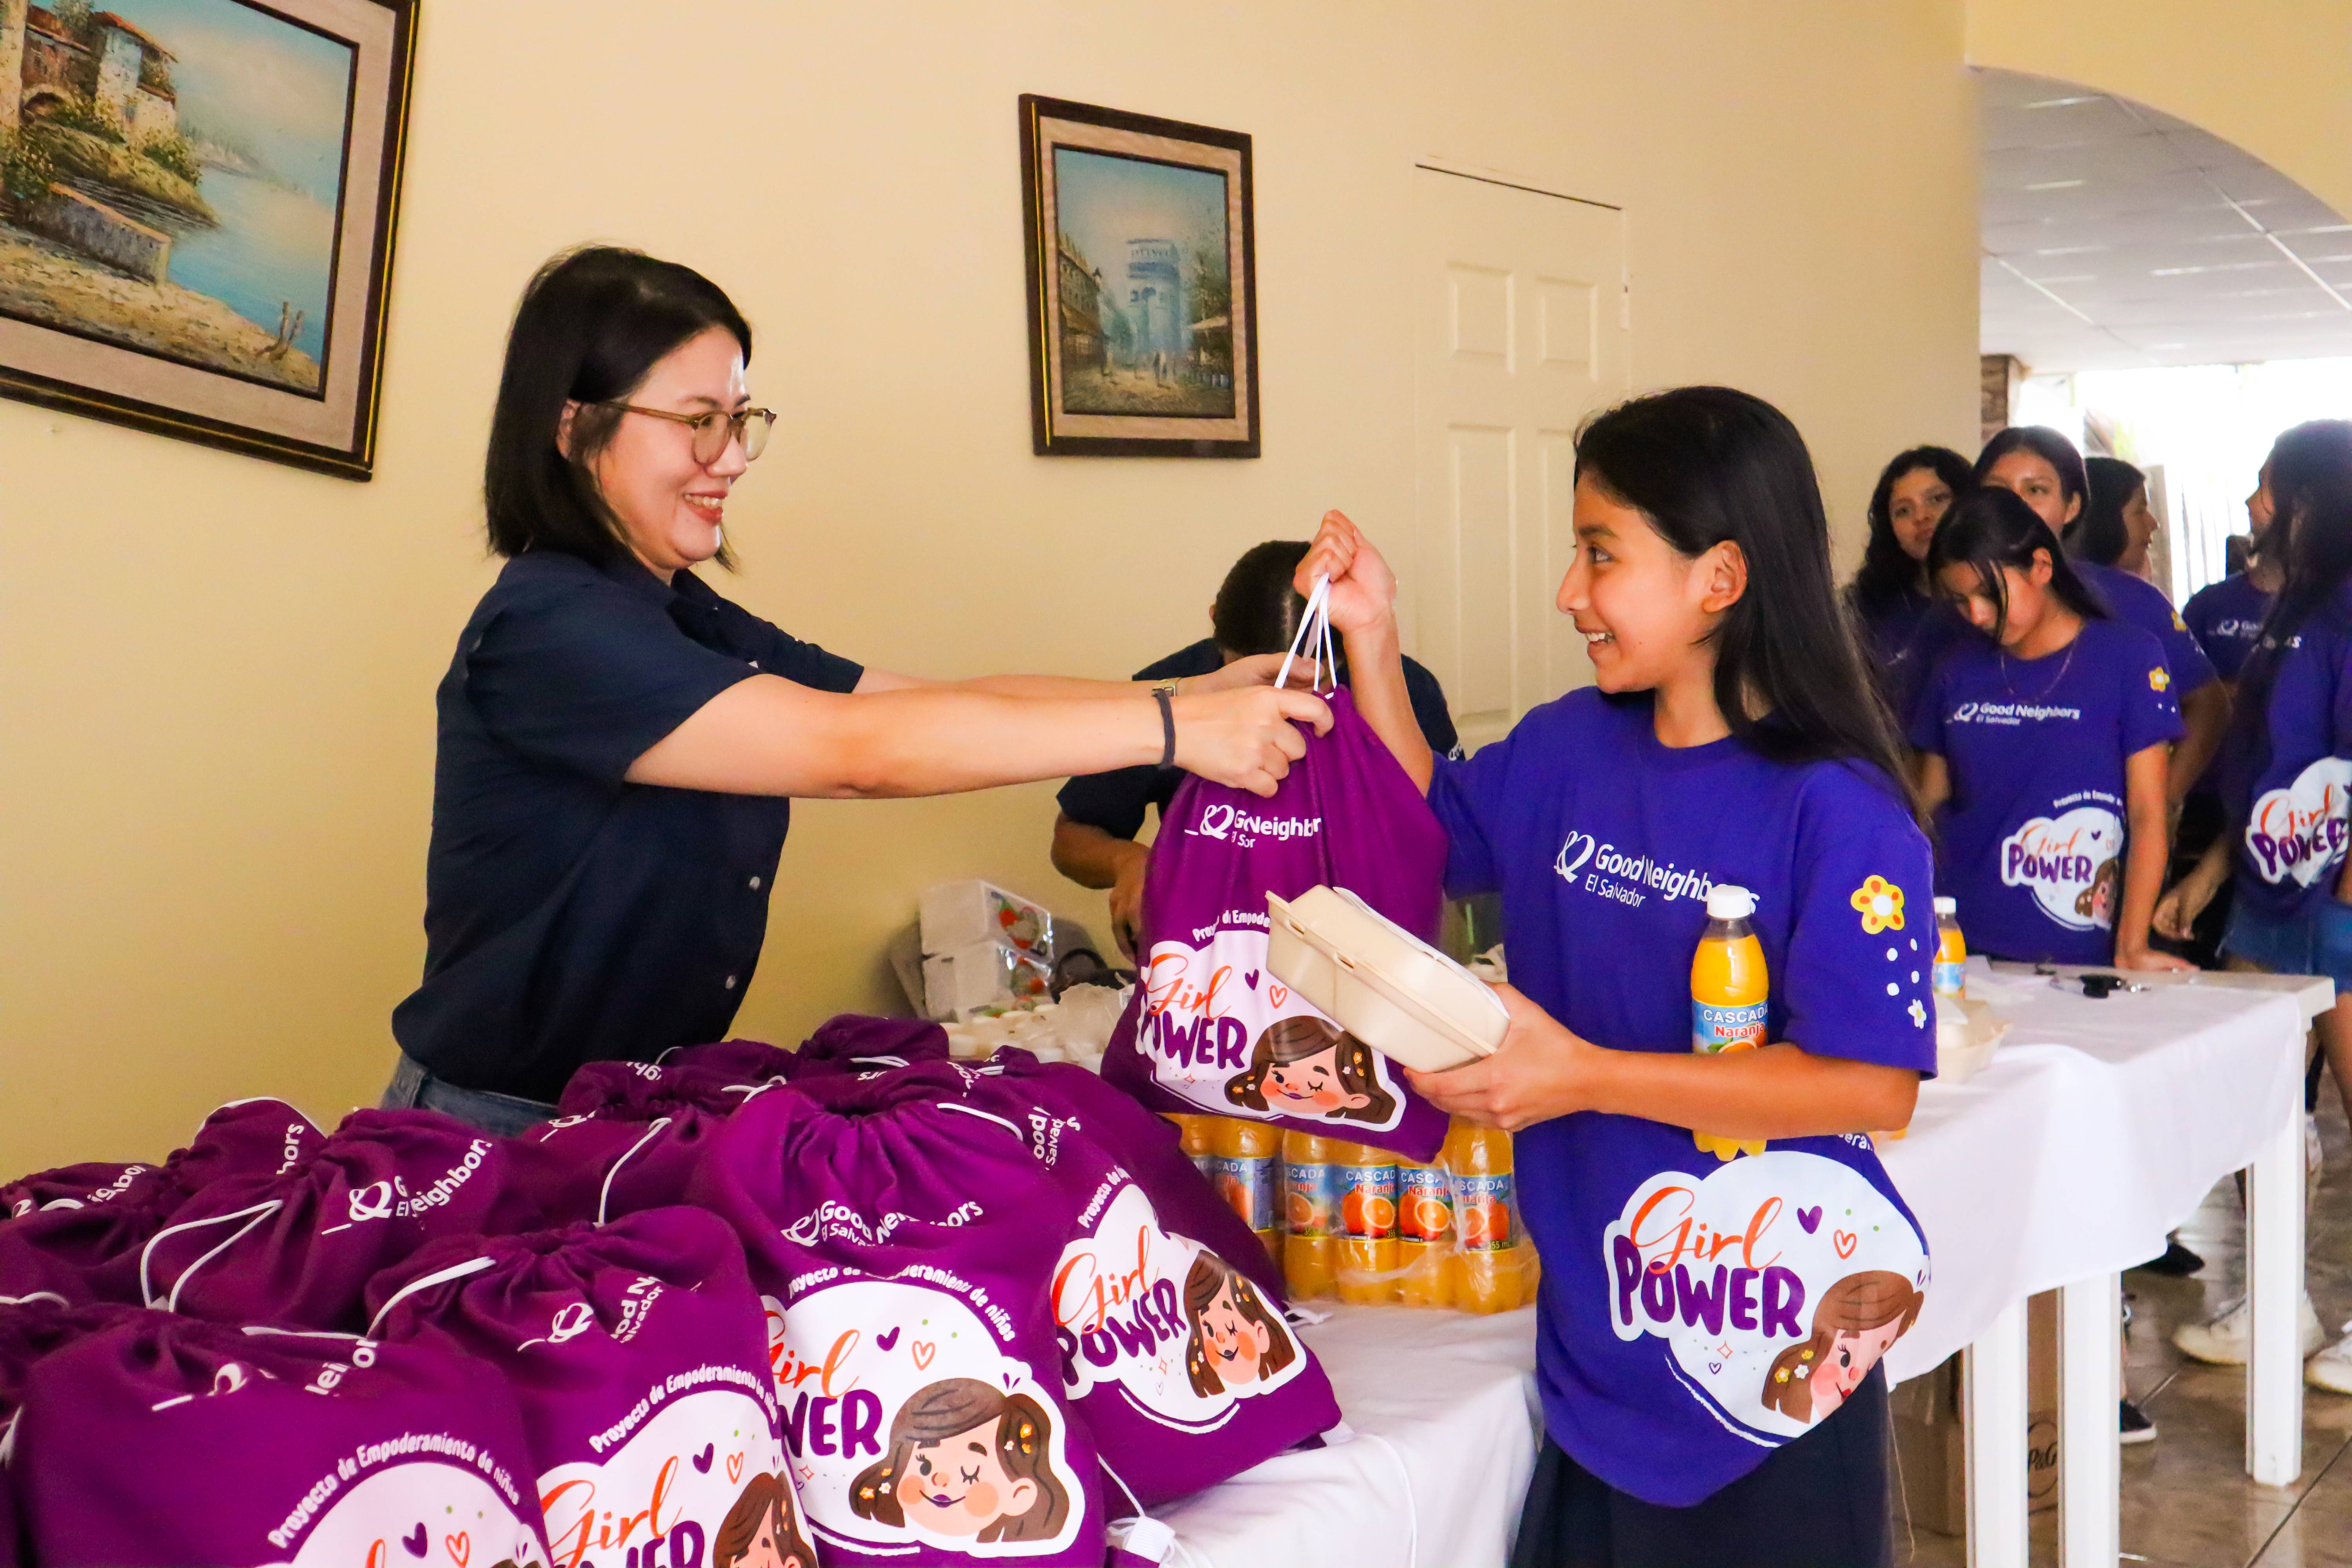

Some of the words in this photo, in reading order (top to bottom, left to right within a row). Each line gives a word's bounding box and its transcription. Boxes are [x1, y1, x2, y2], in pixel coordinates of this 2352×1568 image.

[1595, 844, 1645, 881] Good
[2009, 844, 2092, 883] POWER
[1585, 874, 1599, 892] El
[1598, 879, 1646, 907] Salvador
[1146, 953, 1232, 1020] Girl
[1714, 1022, 1765, 1038] Naranja
[1346, 1170, 1395, 1182] CASCAD
[1630, 1187, 1783, 1275] Girl
[969, 1287, 989, 1307] de
[1051, 1225, 1160, 1335] Girl
[1613, 1234, 1805, 1338] POWER
[588, 1398, 650, 1454] Proyecto
[649, 1385, 666, 1405] de
[268, 1473, 338, 1548] Proyecto
[338, 1458, 358, 1481] de
[357, 1431, 475, 1467] Empoderamiento
[477, 1451, 493, 1474] de
